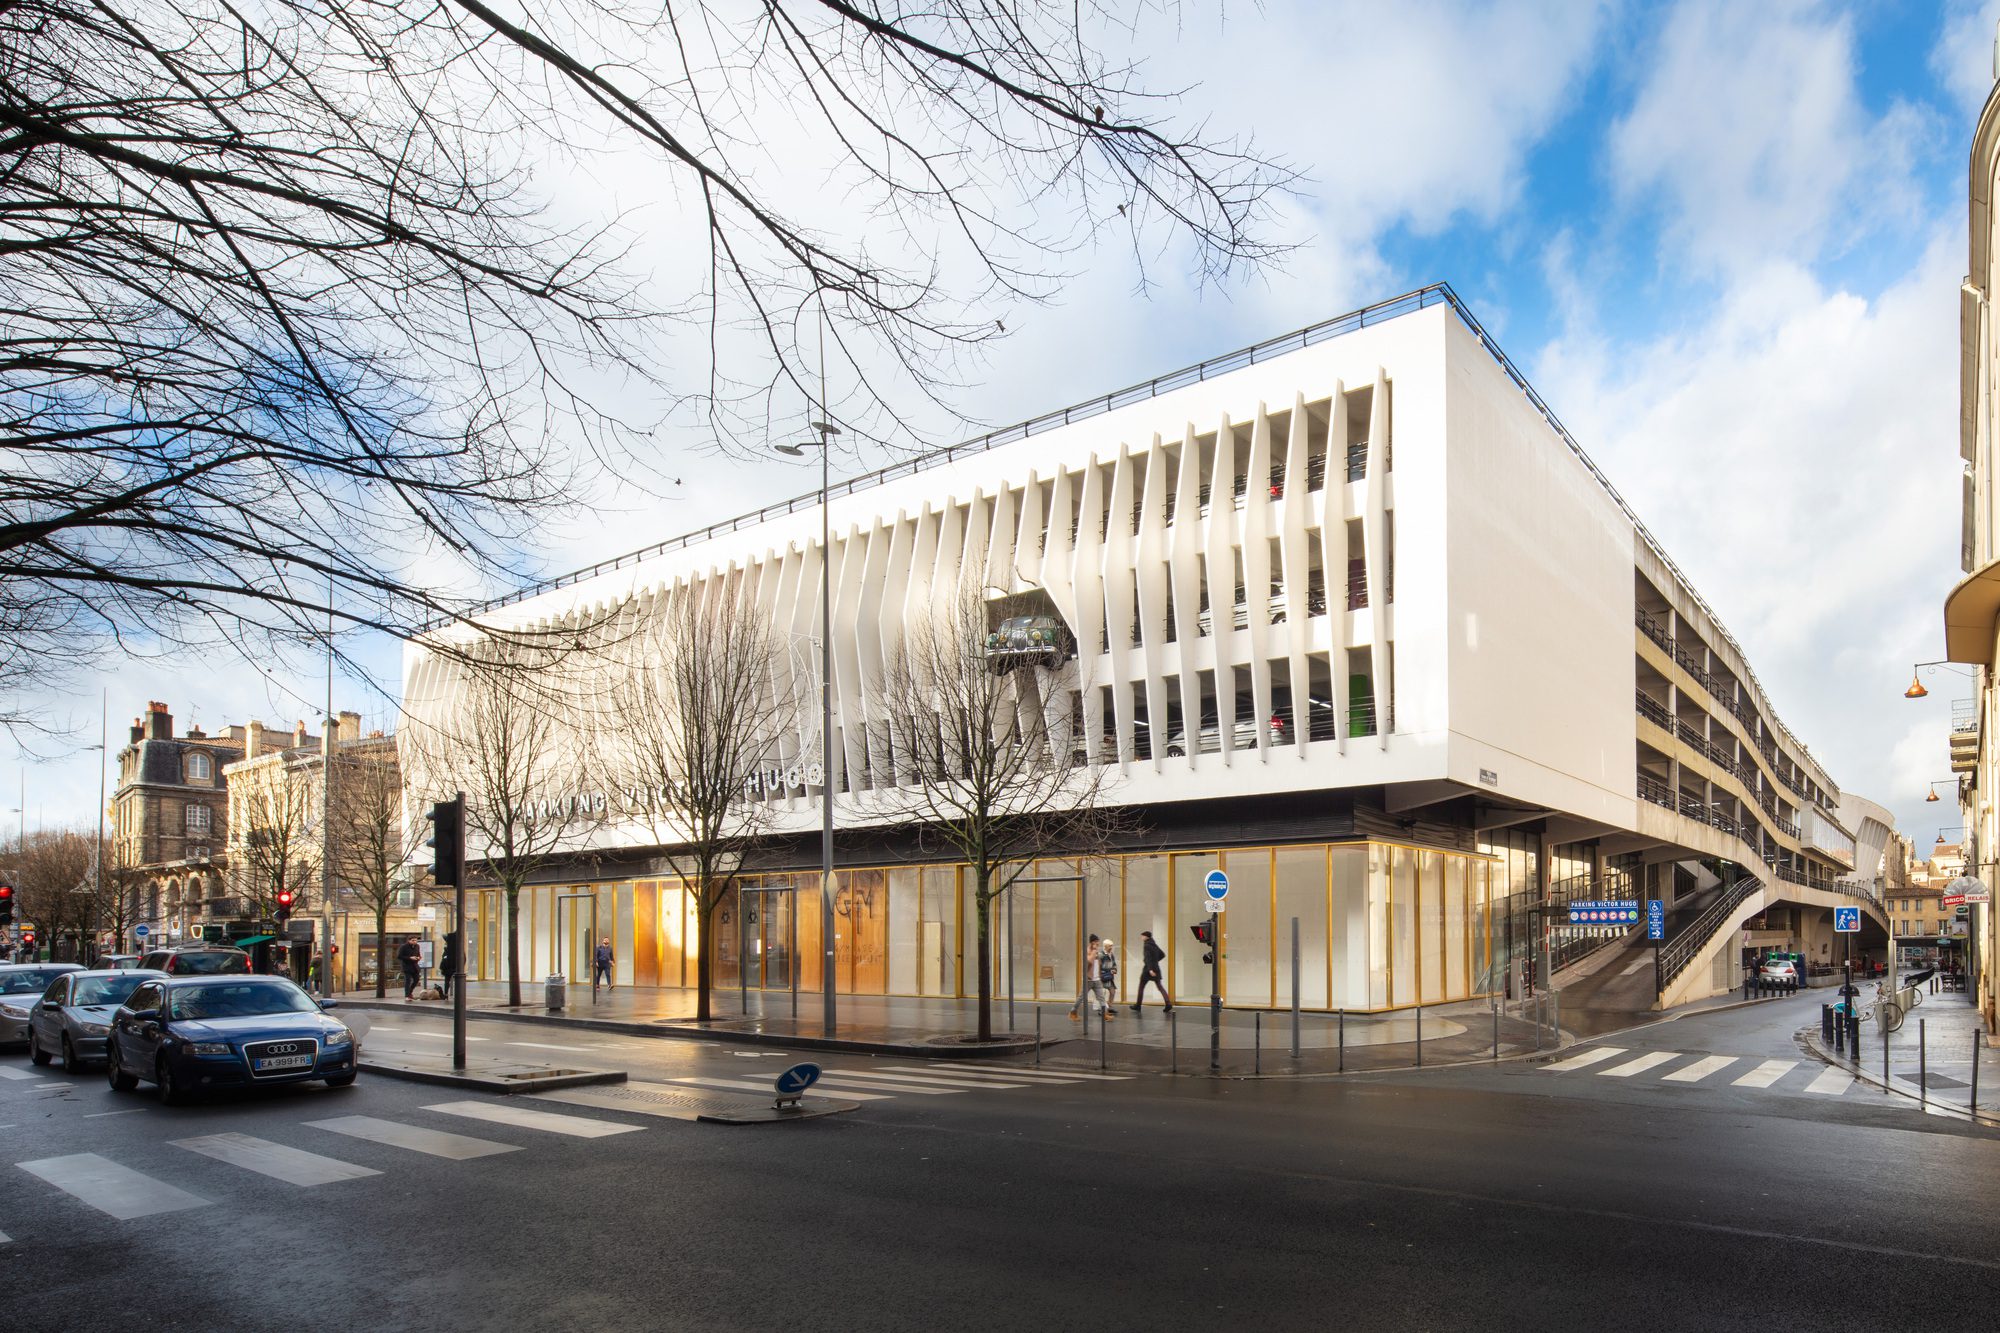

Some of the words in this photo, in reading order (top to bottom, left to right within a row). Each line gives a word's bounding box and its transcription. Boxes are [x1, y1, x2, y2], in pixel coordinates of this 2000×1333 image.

[747, 762, 822, 793] HUGO
[1944, 896, 1965, 904] BRICO
[261, 1056, 306, 1067] EA-999-FR
